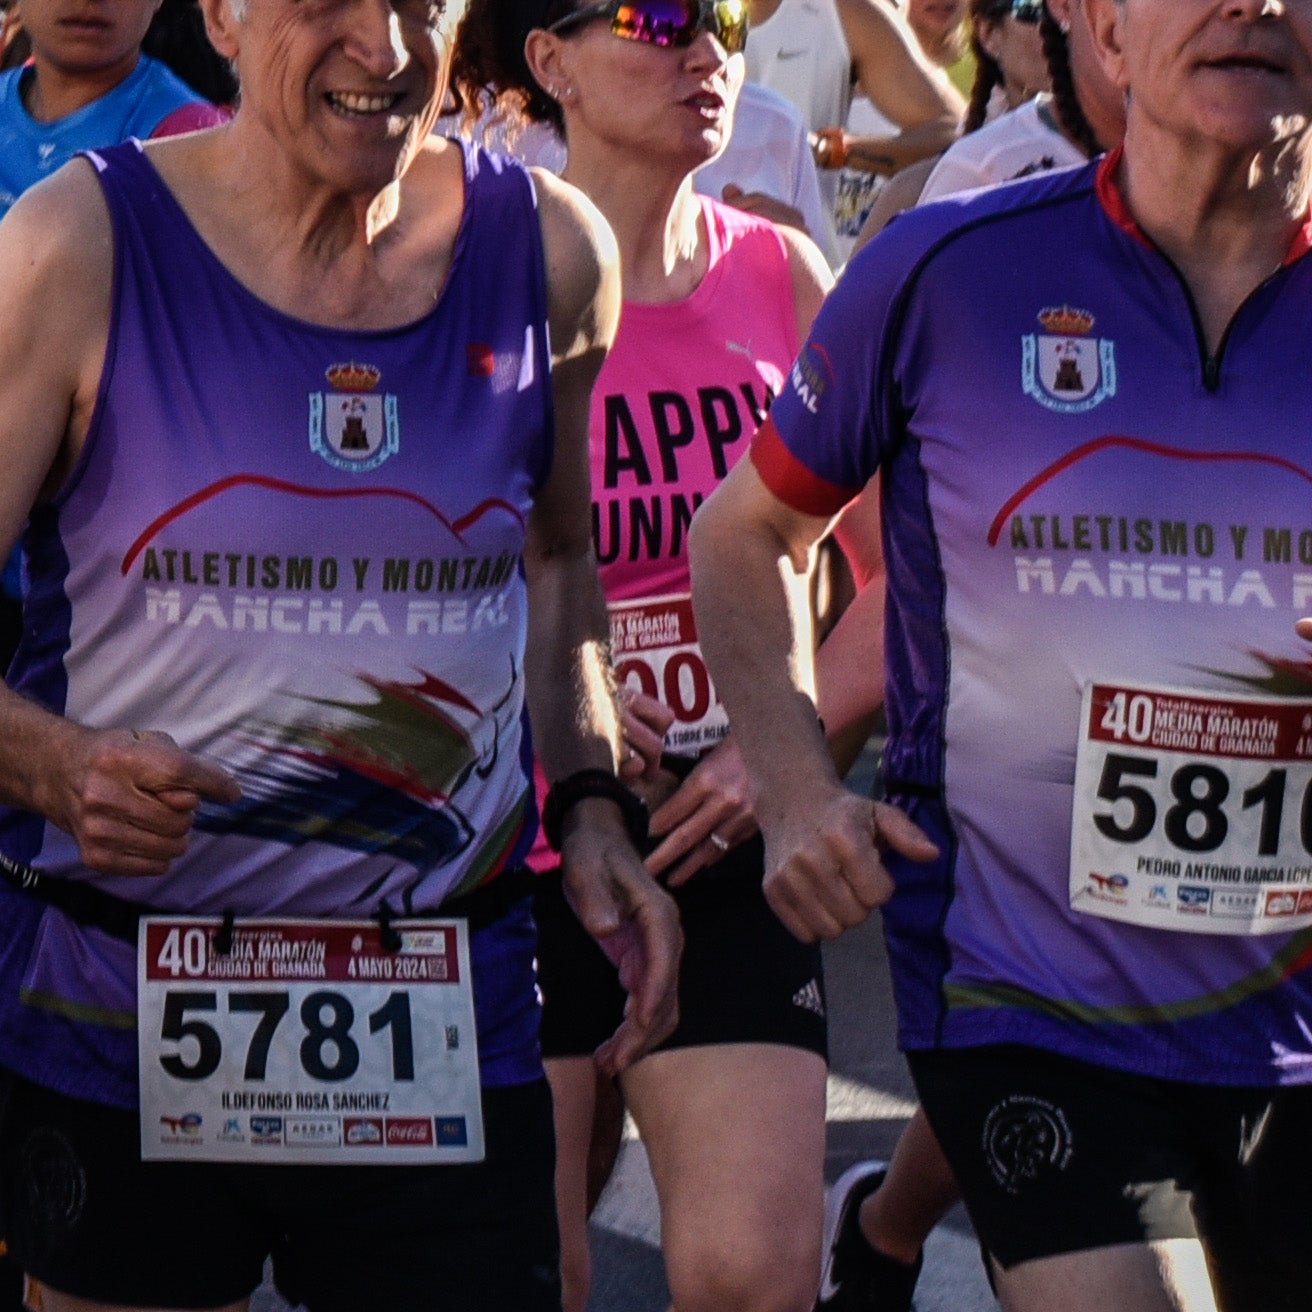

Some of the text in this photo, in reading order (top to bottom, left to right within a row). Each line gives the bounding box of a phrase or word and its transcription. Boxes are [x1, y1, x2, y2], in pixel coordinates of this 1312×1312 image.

[1010, 514, 1215, 560] ATLETISMO
[1229, 525, 1248, 561] Y
[142, 547, 339, 592] ATLETISMO
[352, 556, 370, 592] Y
[1014, 556, 1276, 609] MANCHA
[144, 588, 509, 636] MANCHA REAL
[1100, 691, 1154, 742] 40
[1153, 710, 1279, 738] MEDIA MARATÓN
[1151, 729, 1276, 755] CIUDAD DE GRANADA
[1137, 855, 1182, 878] PEDRO
[1184, 862, 1240, 884] ANTONIO
[1243, 865, 1284, 884] GARCIA
[157, 928, 207, 977] 40
[258, 937, 326, 961] MARATÓN
[347, 957, 428, 978] 4 MAYO 2024
[207, 961, 326, 979] CIUDAD DE GRANADA
[159, 990, 415, 1082] 5781
[221, 1091, 390, 1112] ILDEFONSO ROSA SANCHEZ
